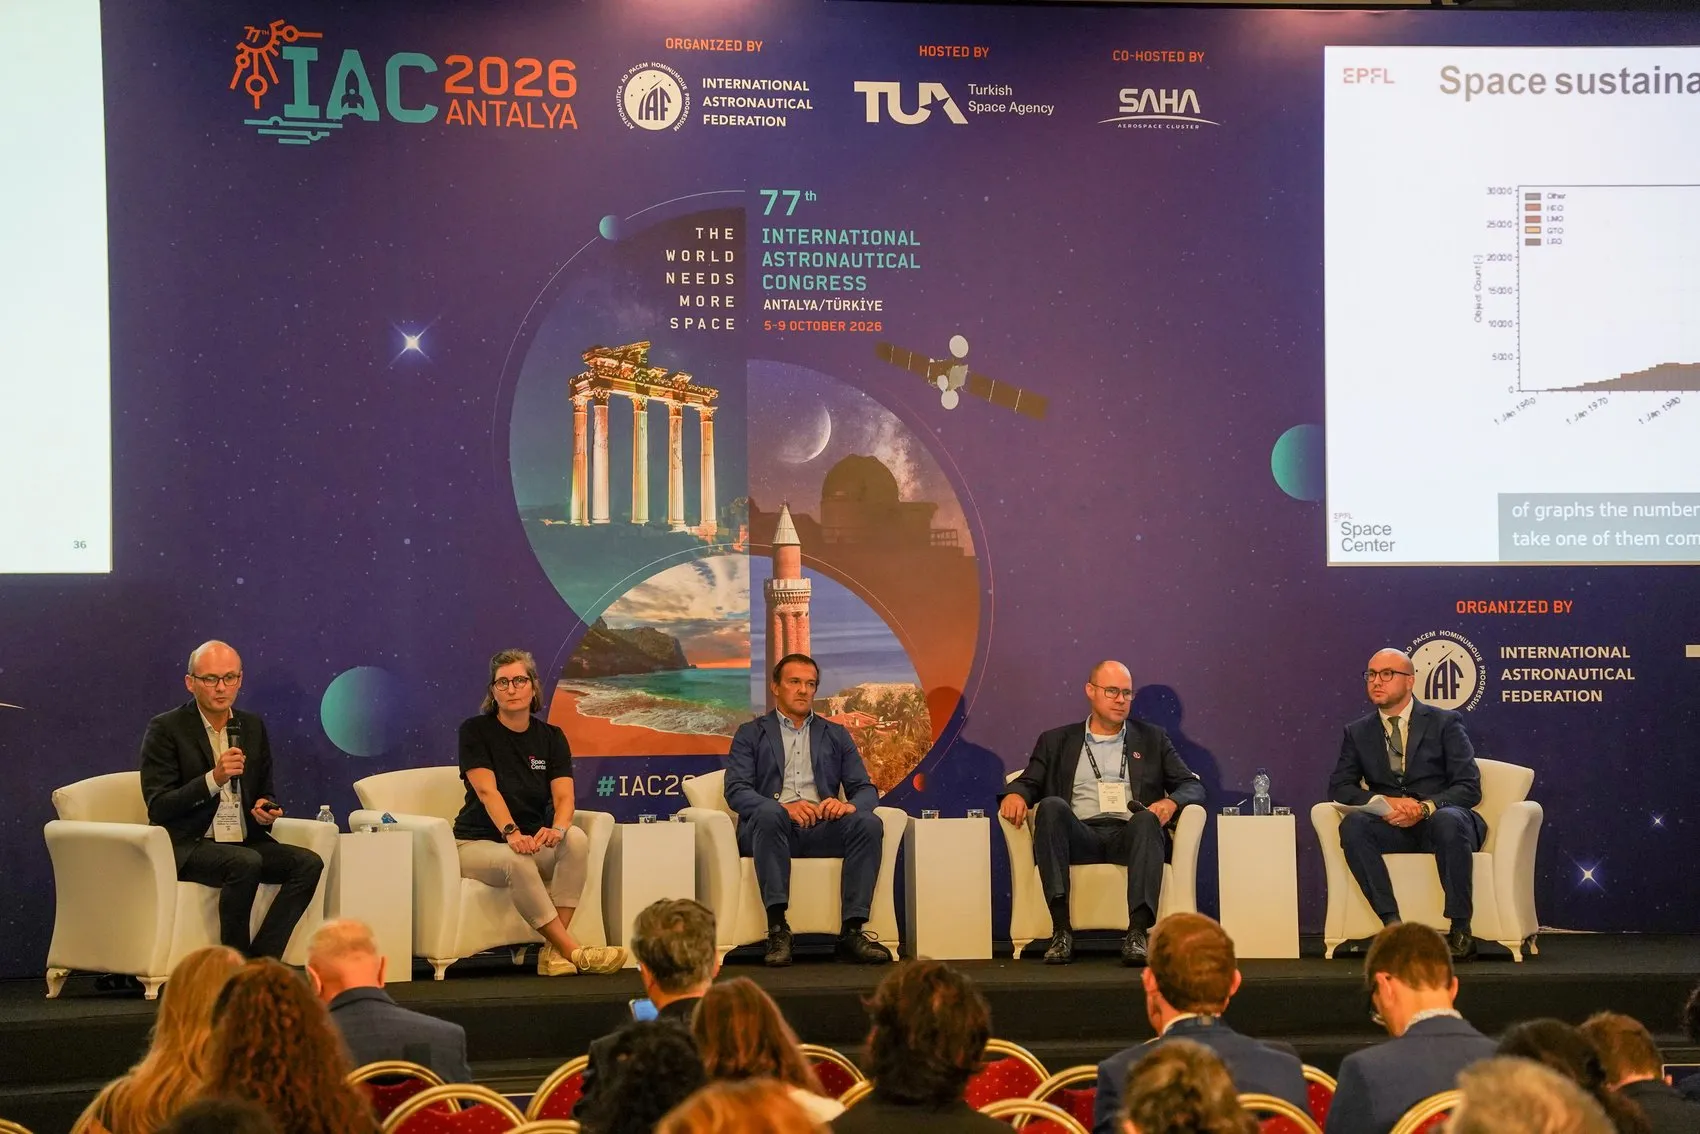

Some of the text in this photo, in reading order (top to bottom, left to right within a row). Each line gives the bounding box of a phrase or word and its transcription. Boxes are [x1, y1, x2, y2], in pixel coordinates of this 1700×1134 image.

[665, 38, 763, 52] ORGANIZED BY
[919, 46, 990, 58] HOSTED BY
[1112, 50, 1205, 63] CO-HOSTED BY
[445, 55, 577, 98] 2026
[1343, 67, 1395, 84] EPFL
[282, 46, 439, 123] IAC
[702, 78, 809, 91] INTERNATIONAL
[968, 83, 1013, 96] Turkish
[1439, 65, 1700, 102] Space sustaina
[616, 62, 690, 131] ASTRONAUTICA AD PACEM HOMINUMQUE PROGRESSUM
[638, 86, 672, 120] IAF
[702, 96, 813, 109] ASTRONAUTICAL
[854, 81, 969, 125] TUA
[1118, 88, 1201, 114] SAHA
[446, 99, 578, 129] ANTALYA
[968, 100, 1055, 116] Space Agency
[703, 114, 787, 127] FEDERATION
[760, 189, 817, 216] 77th
[695, 227, 735, 240] THE
[762, 228, 921, 246] INTERNATIONAL
[665, 249, 734, 262] WORLD
[762, 251, 921, 269] ASTRONAUTICAL
[665, 272, 735, 285] NEEDS
[762, 274, 867, 291] CONGRESS
[679, 295, 735, 308] MORE
[763, 297, 883, 311] ANTALYA/TÜRKİYE
[670, 317, 735, 330] SPACE
[764, 320, 882, 332] 5-9 OCTOBER 2026
[1512, 501, 1700, 521] of graphs the number
[1341, 521, 1392, 538] Space
[73, 540, 87, 549] 36
[1341, 537, 1396, 552] Center
[1512, 530, 1700, 546] take one of them com
[1456, 600, 1573, 614] ORGANIZED BY
[1500, 646, 1631, 659] INTERNATIONAL
[1412, 631, 1436, 646] PACEM
[1439, 630, 1482, 662] HOMINUMQUE
[1466, 665, 1486, 712] PROGRESSUM
[1424, 658, 1464, 699] IAF
[1501, 668, 1636, 681] ASTRONAUTICAL
[1501, 689, 1603, 703] FEDERATION
[596, 774, 697, 796] #IAC2
